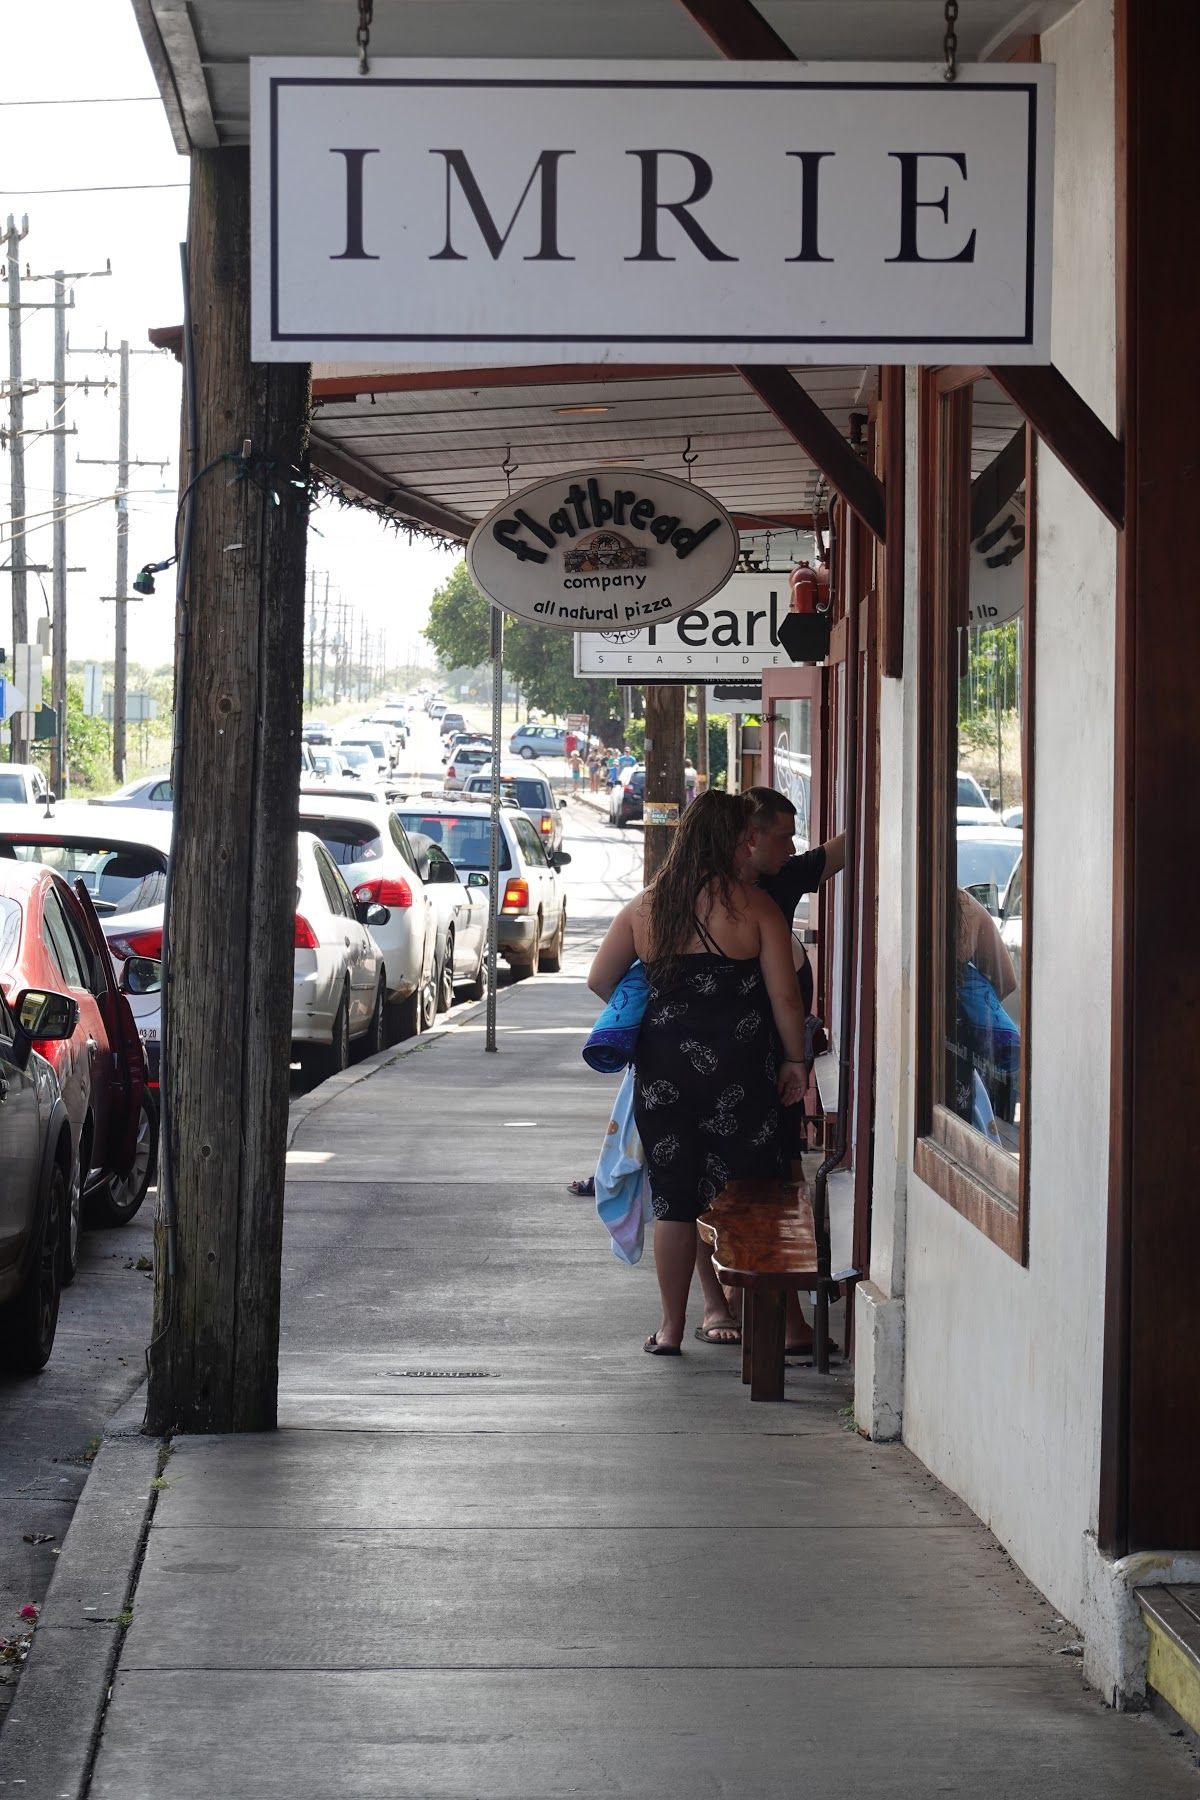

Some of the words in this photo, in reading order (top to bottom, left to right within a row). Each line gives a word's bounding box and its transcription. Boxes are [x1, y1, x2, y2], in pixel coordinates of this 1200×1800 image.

[328, 148, 977, 264] IMRIE
[493, 478, 721, 564] flatbread
[563, 575, 647, 591] company
[533, 600, 555, 616] all
[559, 603, 618, 620] natural
[625, 597, 673, 619] pizza
[597, 655, 779, 665] SEASIDE
[149, 1029, 157, 1038] 20
